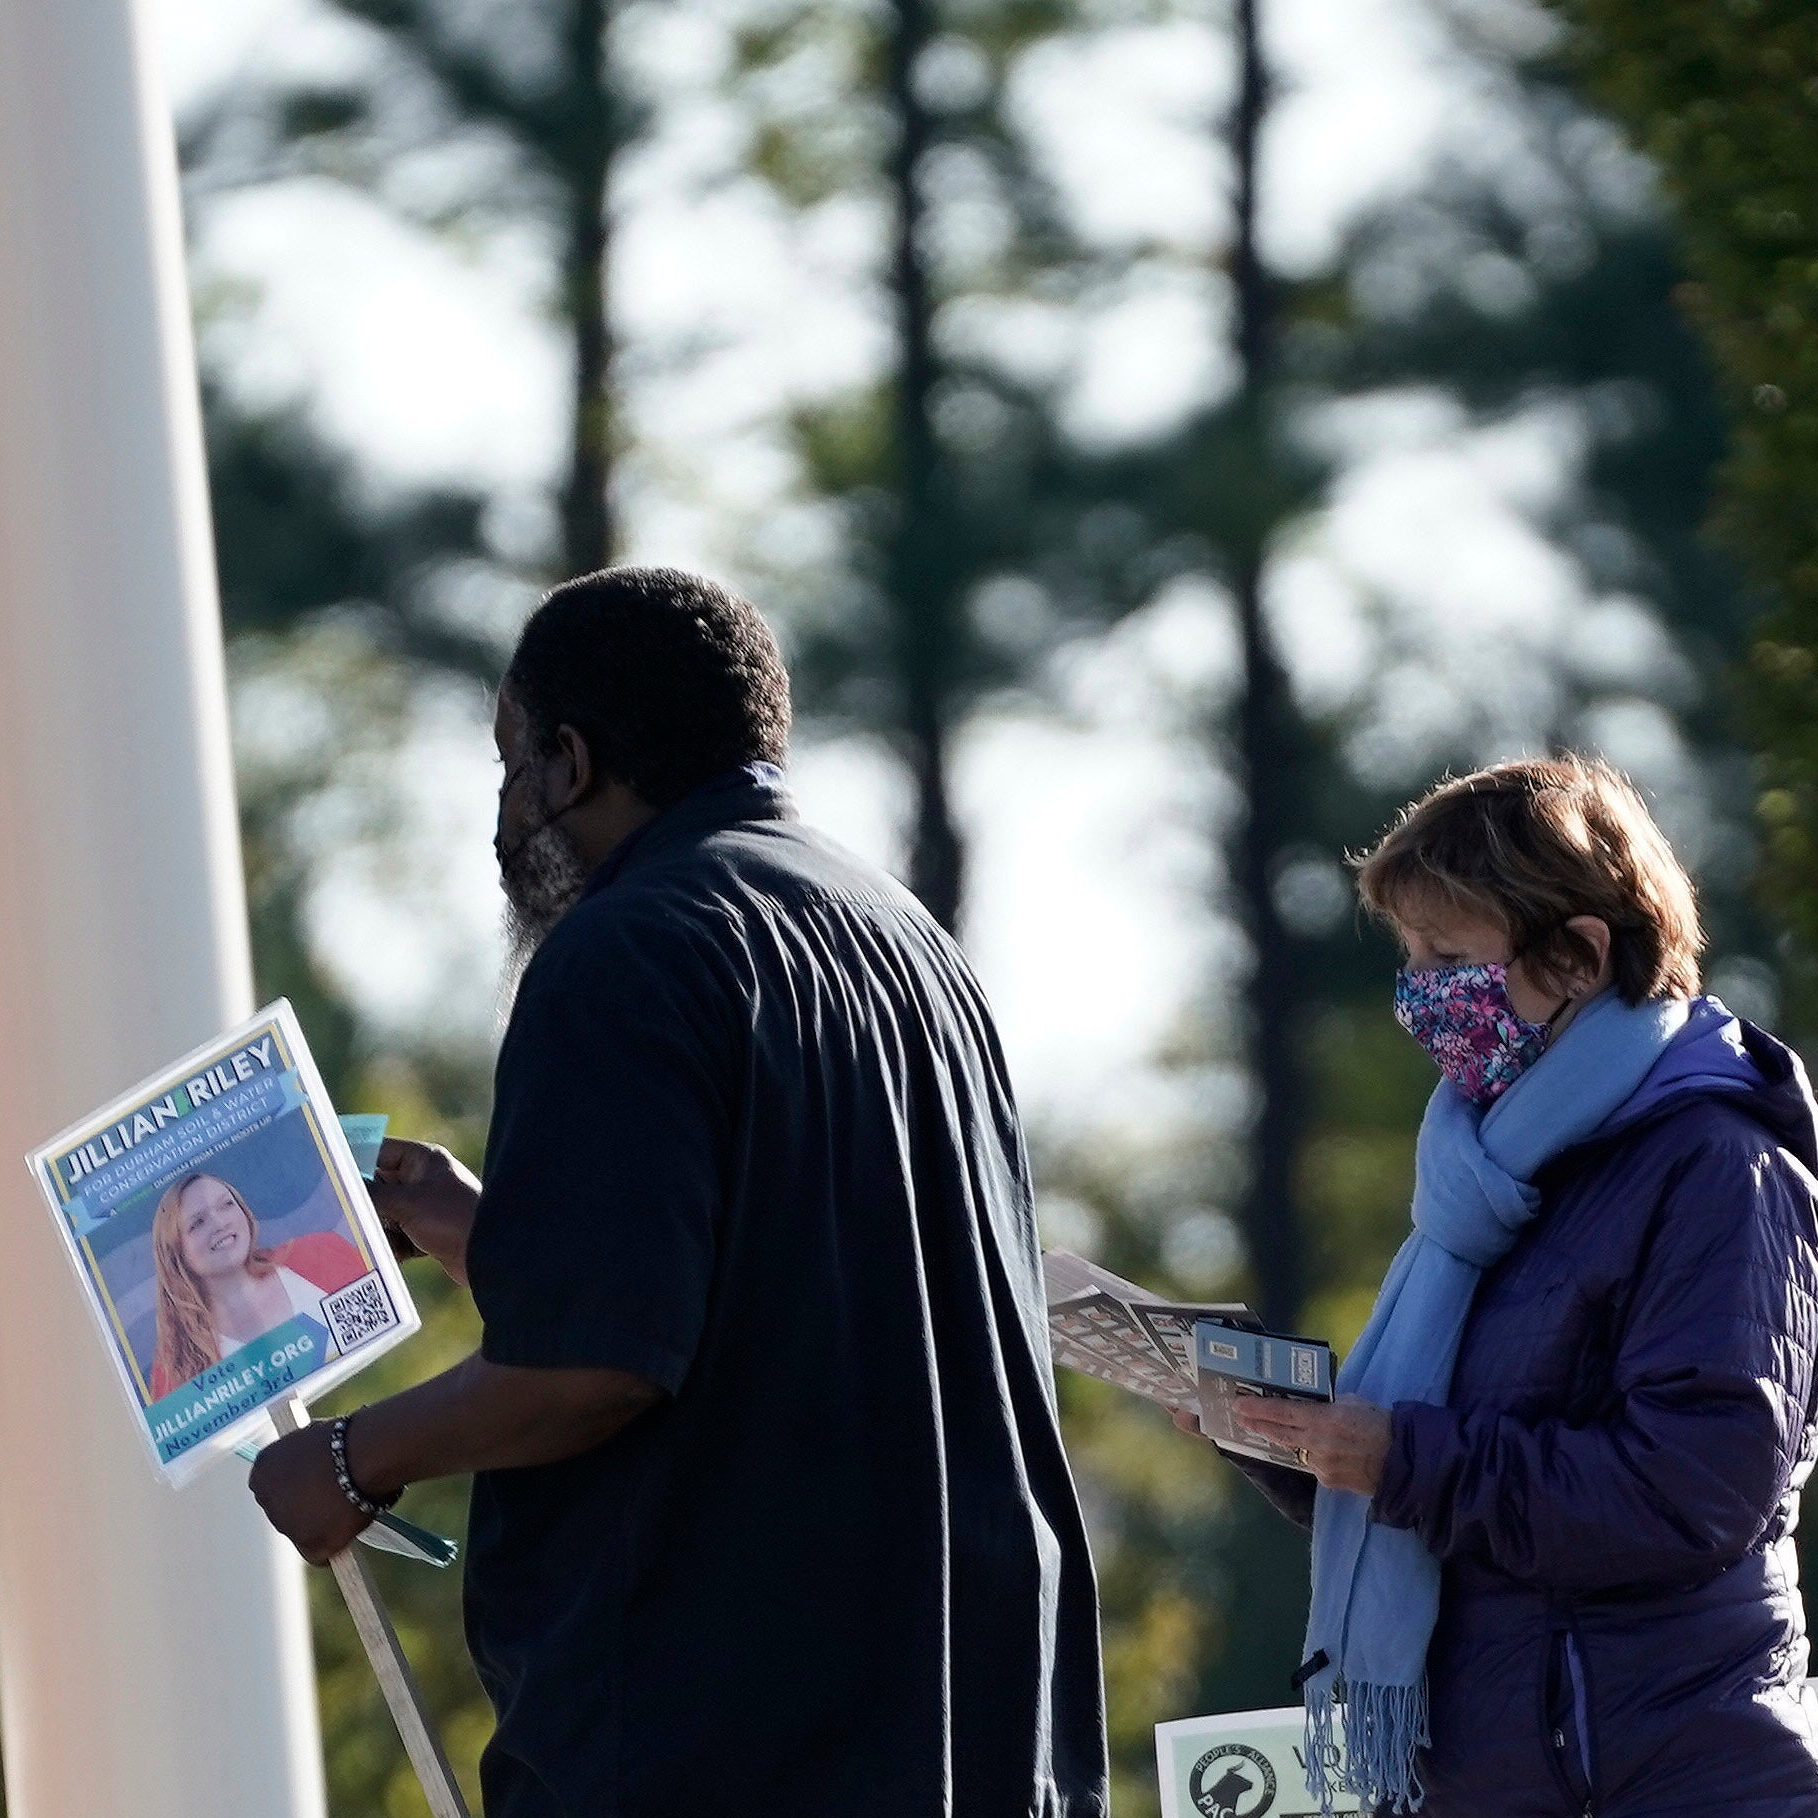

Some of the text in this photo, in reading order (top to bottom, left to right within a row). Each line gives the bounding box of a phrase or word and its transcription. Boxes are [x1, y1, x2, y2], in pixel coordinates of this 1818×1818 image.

[68, 1037, 272, 1185] JILLIAN RILEY
[84, 1173, 112, 1197] FOR
[115, 1134, 176, 1177] DURHAM
[178, 1116, 208, 1139] SOIL
[223, 1077, 275, 1112] WATER
[99, 1136, 204, 1203] CONSERVATION
[207, 1098, 269, 1140] DISTRICT
[155, 1335, 315, 1443] JILLIANRILEY.ORG
[164, 1391, 258, 1457] November
[193, 1362, 236, 1391] Vote
